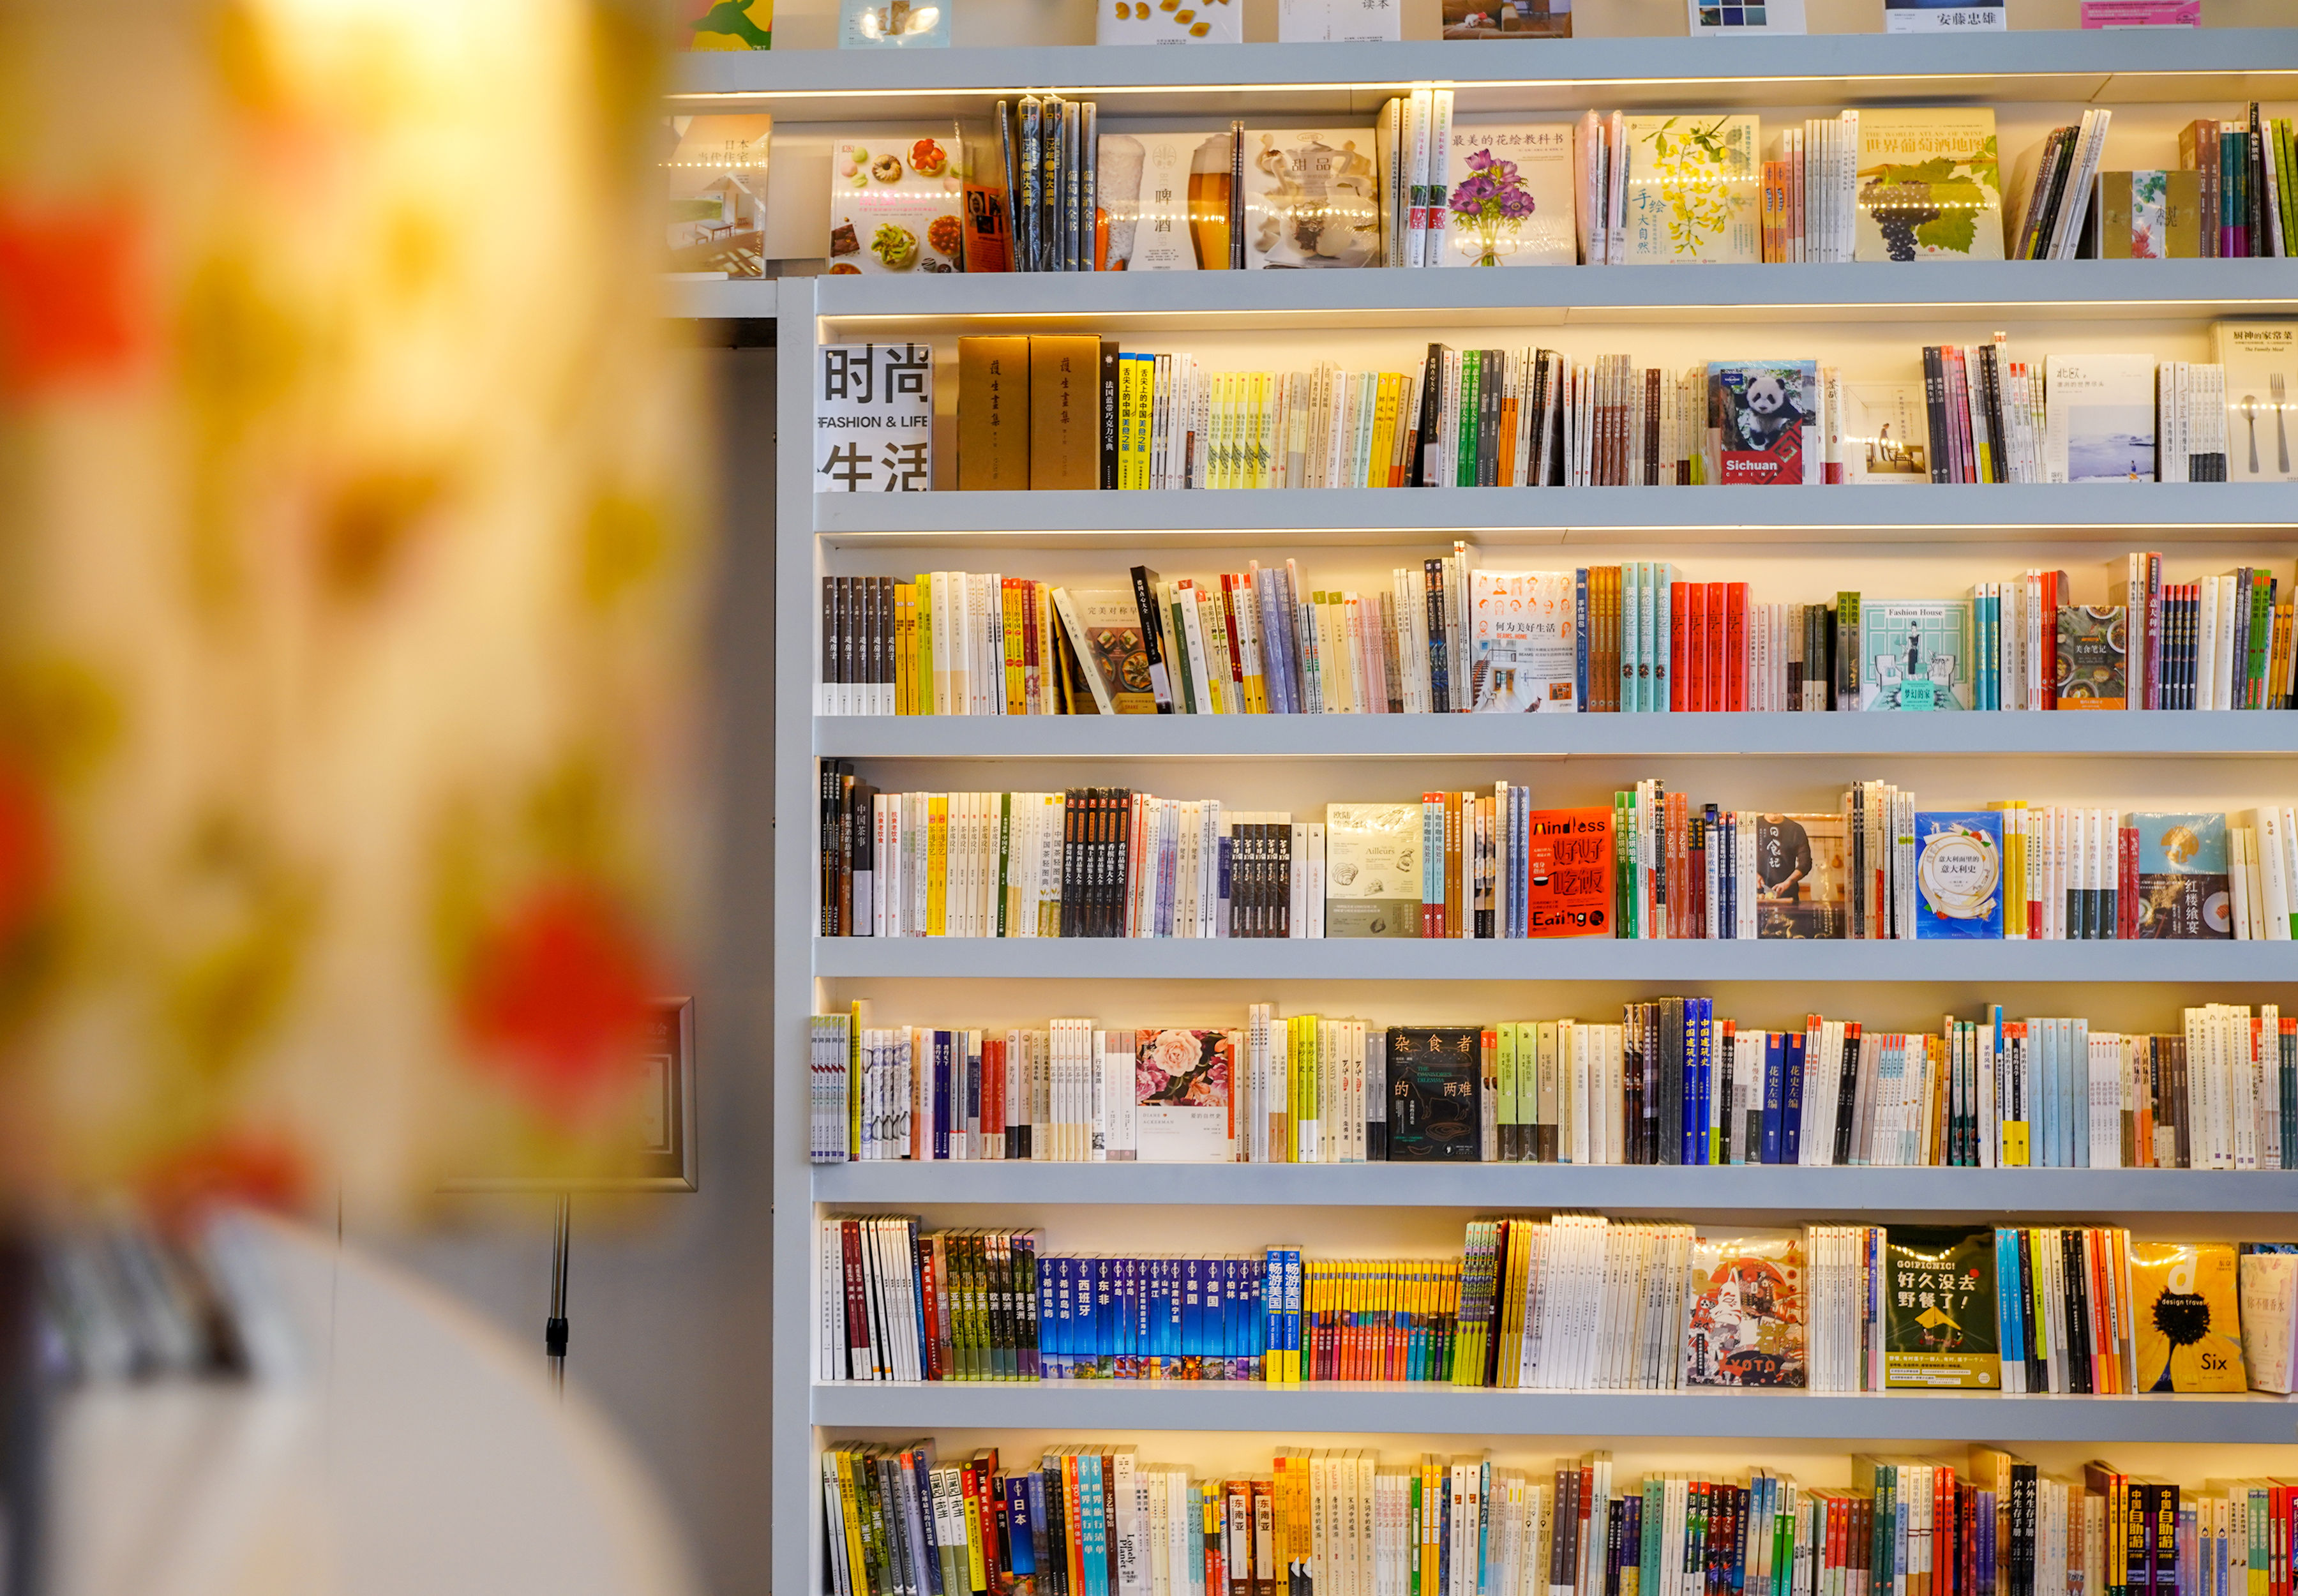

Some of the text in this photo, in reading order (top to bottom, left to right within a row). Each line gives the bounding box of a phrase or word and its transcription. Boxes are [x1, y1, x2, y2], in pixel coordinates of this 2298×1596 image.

[1937, 11, 1996, 26] 安藤忠雄
[1452, 133, 1563, 146] 最美的花绘教科书
[1865, 137, 1985, 154] 世界葡萄酒地图
[1155, 188, 1172, 232] 啤酒
[886, 417, 896, 427] &
[901, 416, 927, 428] LIFE
[1726, 460, 1777, 471] Sichuan
[1496, 622, 1556, 633] 何为美好生活
[1904, 689, 1930, 699] 梦幻的家
[857, 804, 866, 847] 中国茶事
[1941, 865, 1976, 873] 意大利史
[1394, 1034, 1473, 1052] 杂食者
[1686, 1019, 1695, 1067] 中国建筑史
[1701, 1019, 1710, 1066] 中国建筑史
[1098, 1281, 1109, 1306] 东非
[1151, 1281, 1159, 1298] 浙江
[1161, 1280, 1168, 1295] 山东
[1187, 1280, 1198, 1305] 泰国
[1206, 1281, 1219, 1307] 德国
[1226, 1281, 1235, 1299] 柏林
[1240, 1281, 1249, 1300] 广西
[1268, 1263, 1282, 1309] 畅游美国
[1285, 1263, 1299, 1309] 畅游美国
[1897, 1272, 1976, 1291] 好久没去
[1043, 1279, 1053, 1318] 希腊岛屿
[1059, 1279, 1069, 1319] 希腊岛屿
[1078, 1279, 1091, 1316] 西班牙
[2201, 1353, 2227, 1370] Six
[1014, 1498, 1026, 1525] 日本
[1234, 1498, 1244, 1532] 东南亚
[1260, 1498, 1269, 1532] 东南亚
[2013, 1479, 2022, 1537] 户外生存手册
[2025, 1479, 2034, 1537] 户外生存手册
[1125, 1533, 1135, 1565] Lonely
